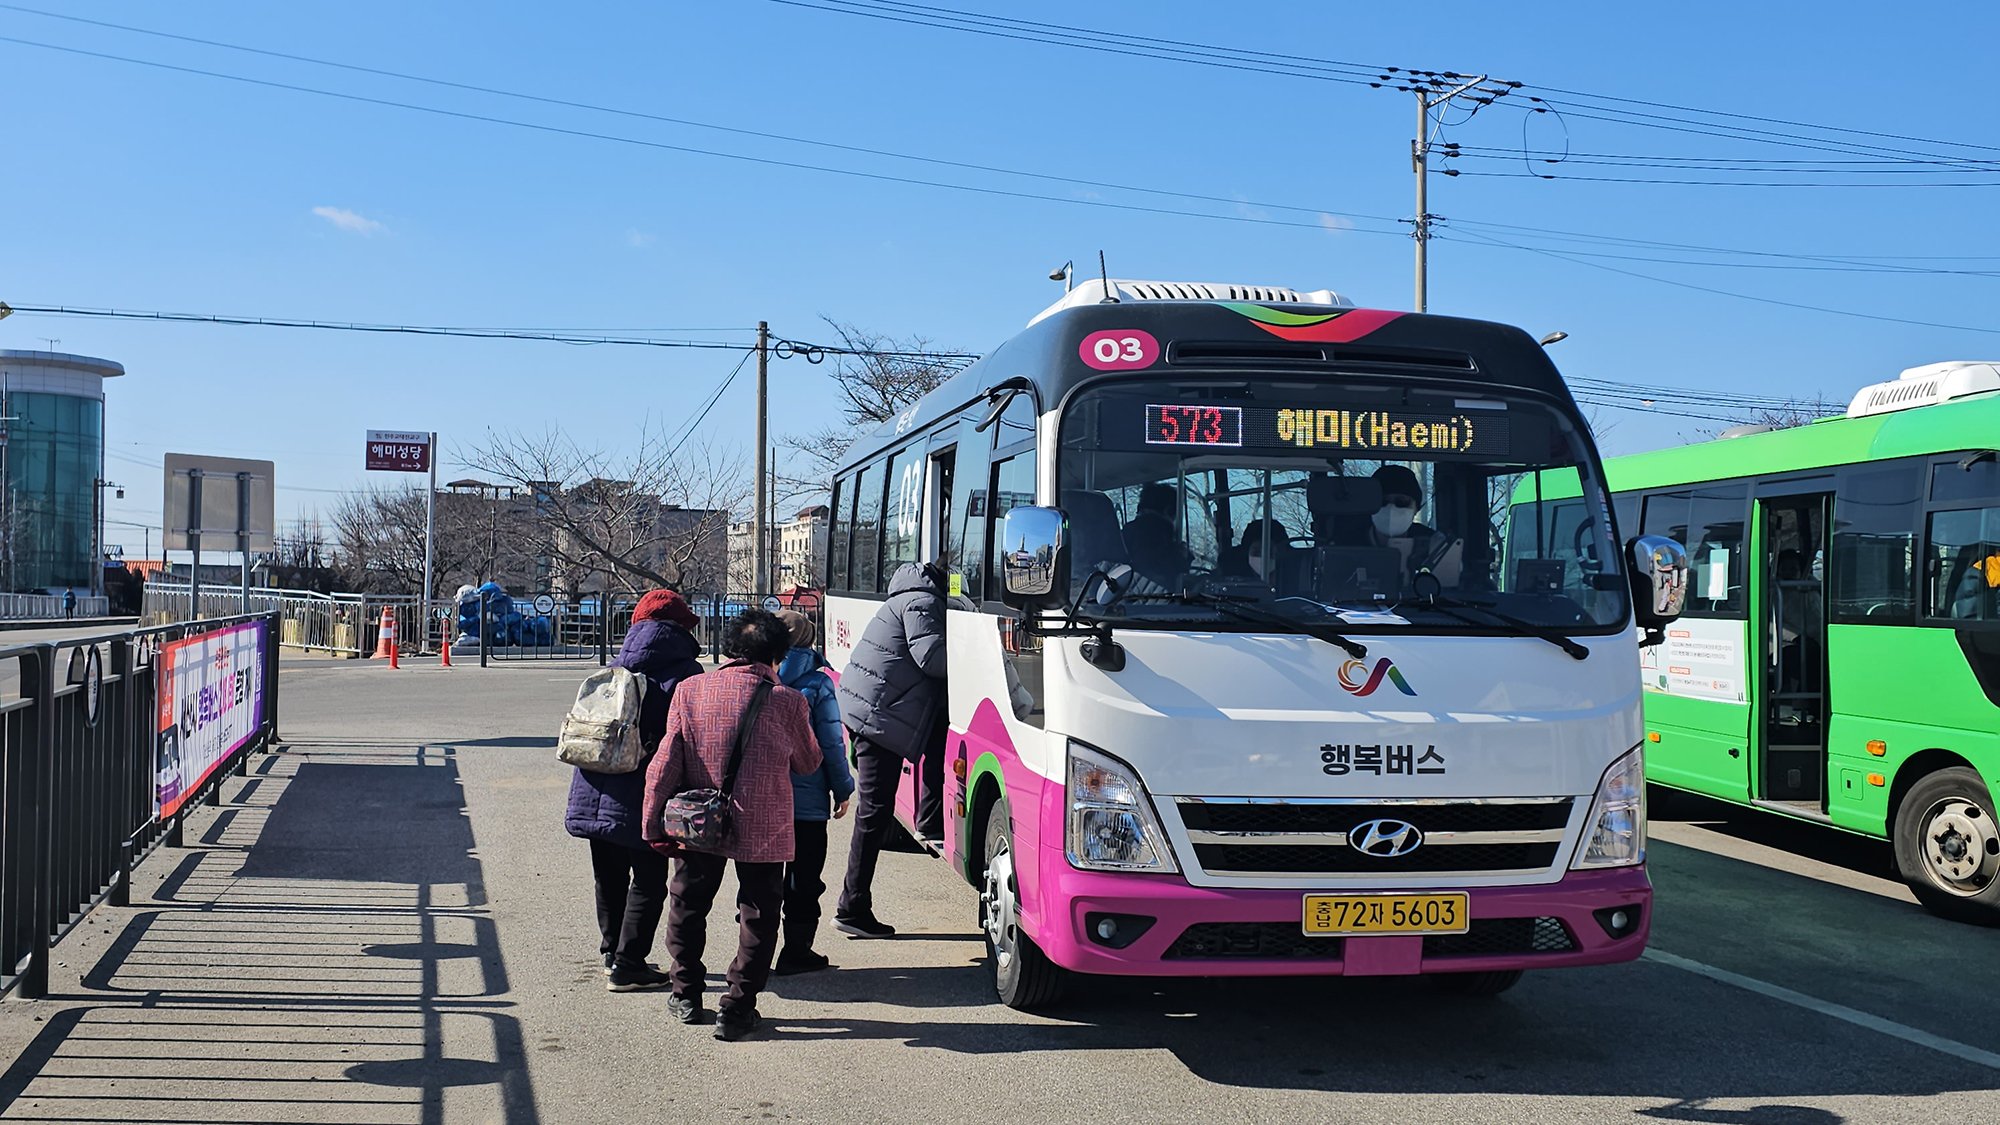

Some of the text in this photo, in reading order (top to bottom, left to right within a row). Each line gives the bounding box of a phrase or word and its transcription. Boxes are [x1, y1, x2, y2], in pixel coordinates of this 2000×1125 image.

[1094, 337, 1144, 363] 03
[1161, 404, 1222, 443] 573
[1277, 408, 1474, 452] 해미(Haemi)
[371, 444, 423, 460] 해미성당
[899, 459, 920, 538] 03
[1320, 743, 1446, 776] 행복버스
[1334, 901, 1384, 927] 72자
[1392, 900, 1455, 926] 5603
